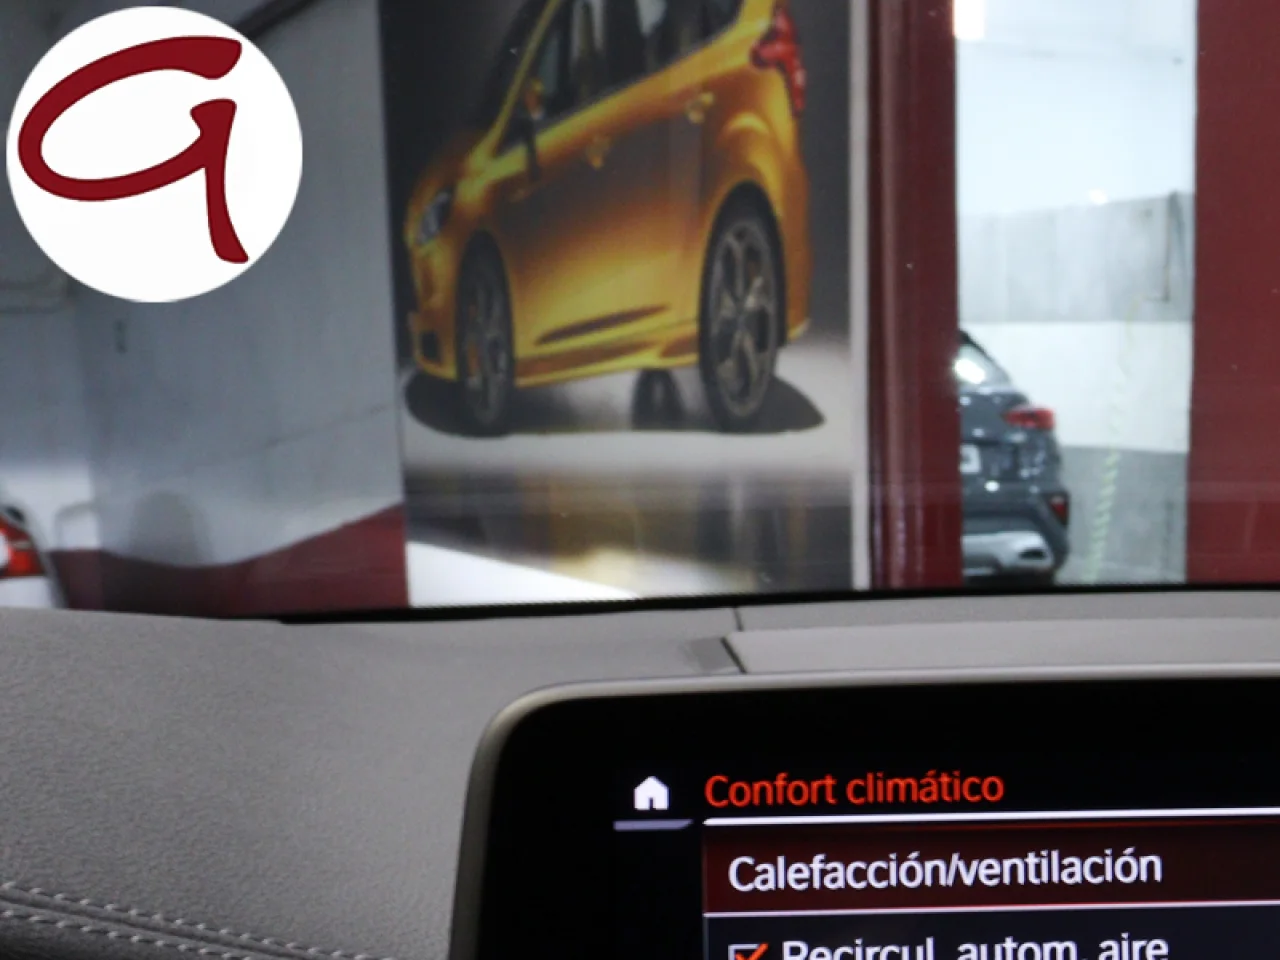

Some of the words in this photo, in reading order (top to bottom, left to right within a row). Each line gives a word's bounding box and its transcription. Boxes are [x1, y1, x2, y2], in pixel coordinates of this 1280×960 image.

[704, 772, 837, 806] Confort
[846, 770, 1004, 804] climático
[728, 846, 1163, 892] Calefacción/ventilación
